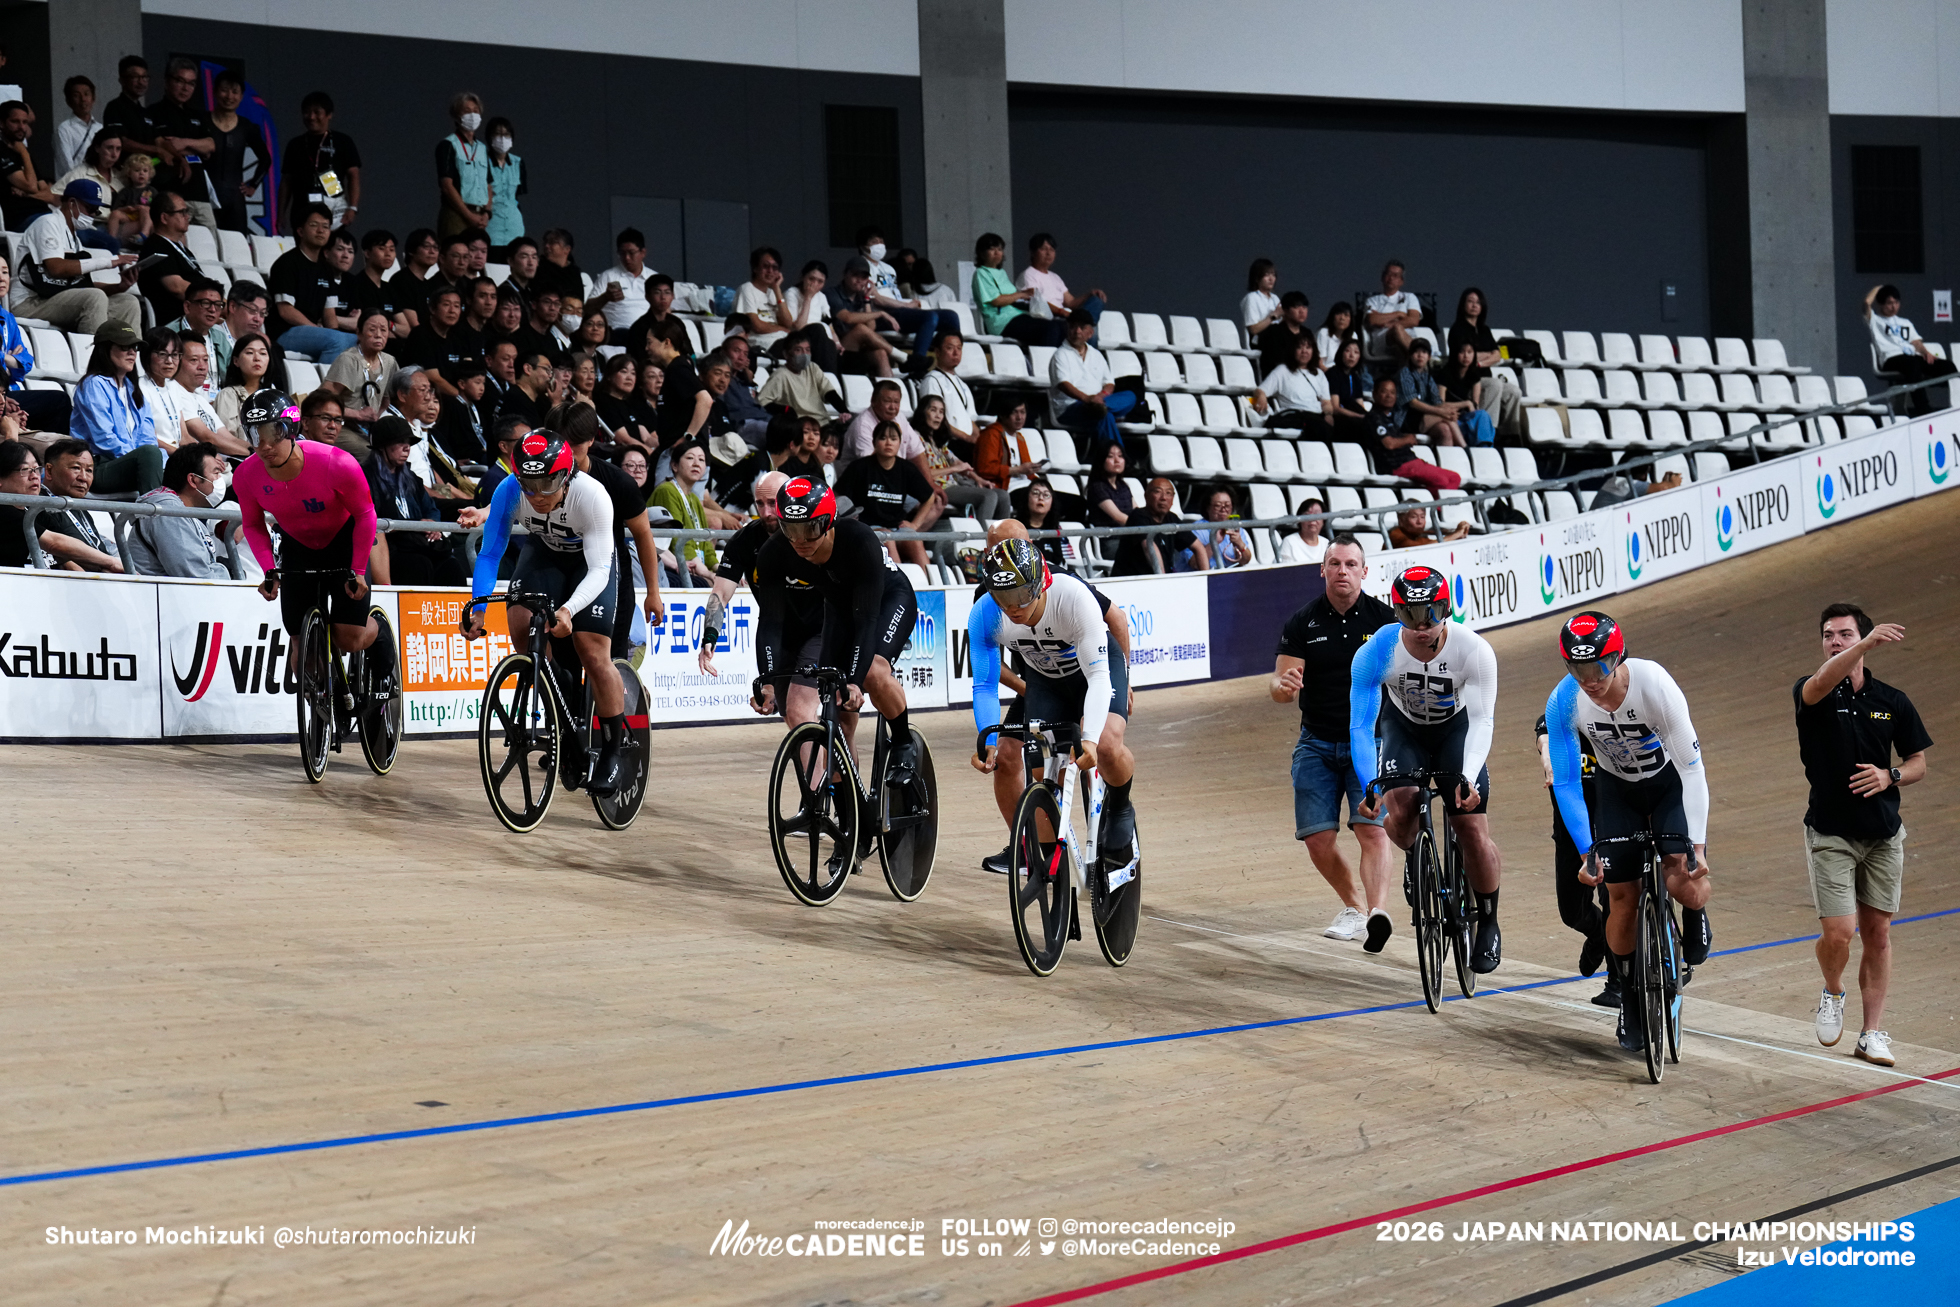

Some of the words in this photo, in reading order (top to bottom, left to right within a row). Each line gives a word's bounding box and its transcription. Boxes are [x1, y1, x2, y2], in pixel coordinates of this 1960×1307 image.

[1839, 450, 1897, 501] NIPPO
[1736, 484, 1789, 534] NIPPO
[1645, 512, 1691, 562] NIPPO
[1469, 569, 1518, 621] NIPPO
[1558, 547, 1604, 599] NIPPO
[883, 604, 906, 644] CASTELLI
[405, 631, 517, 684] 静岡県自転
[765, 645, 773, 673] CASTEL
[850, 645, 860, 676] CASTELLI
[375, 692, 390, 700] T20
[655, 697, 673, 709] TEL
[675, 694, 750, 707] 055-948-0304
